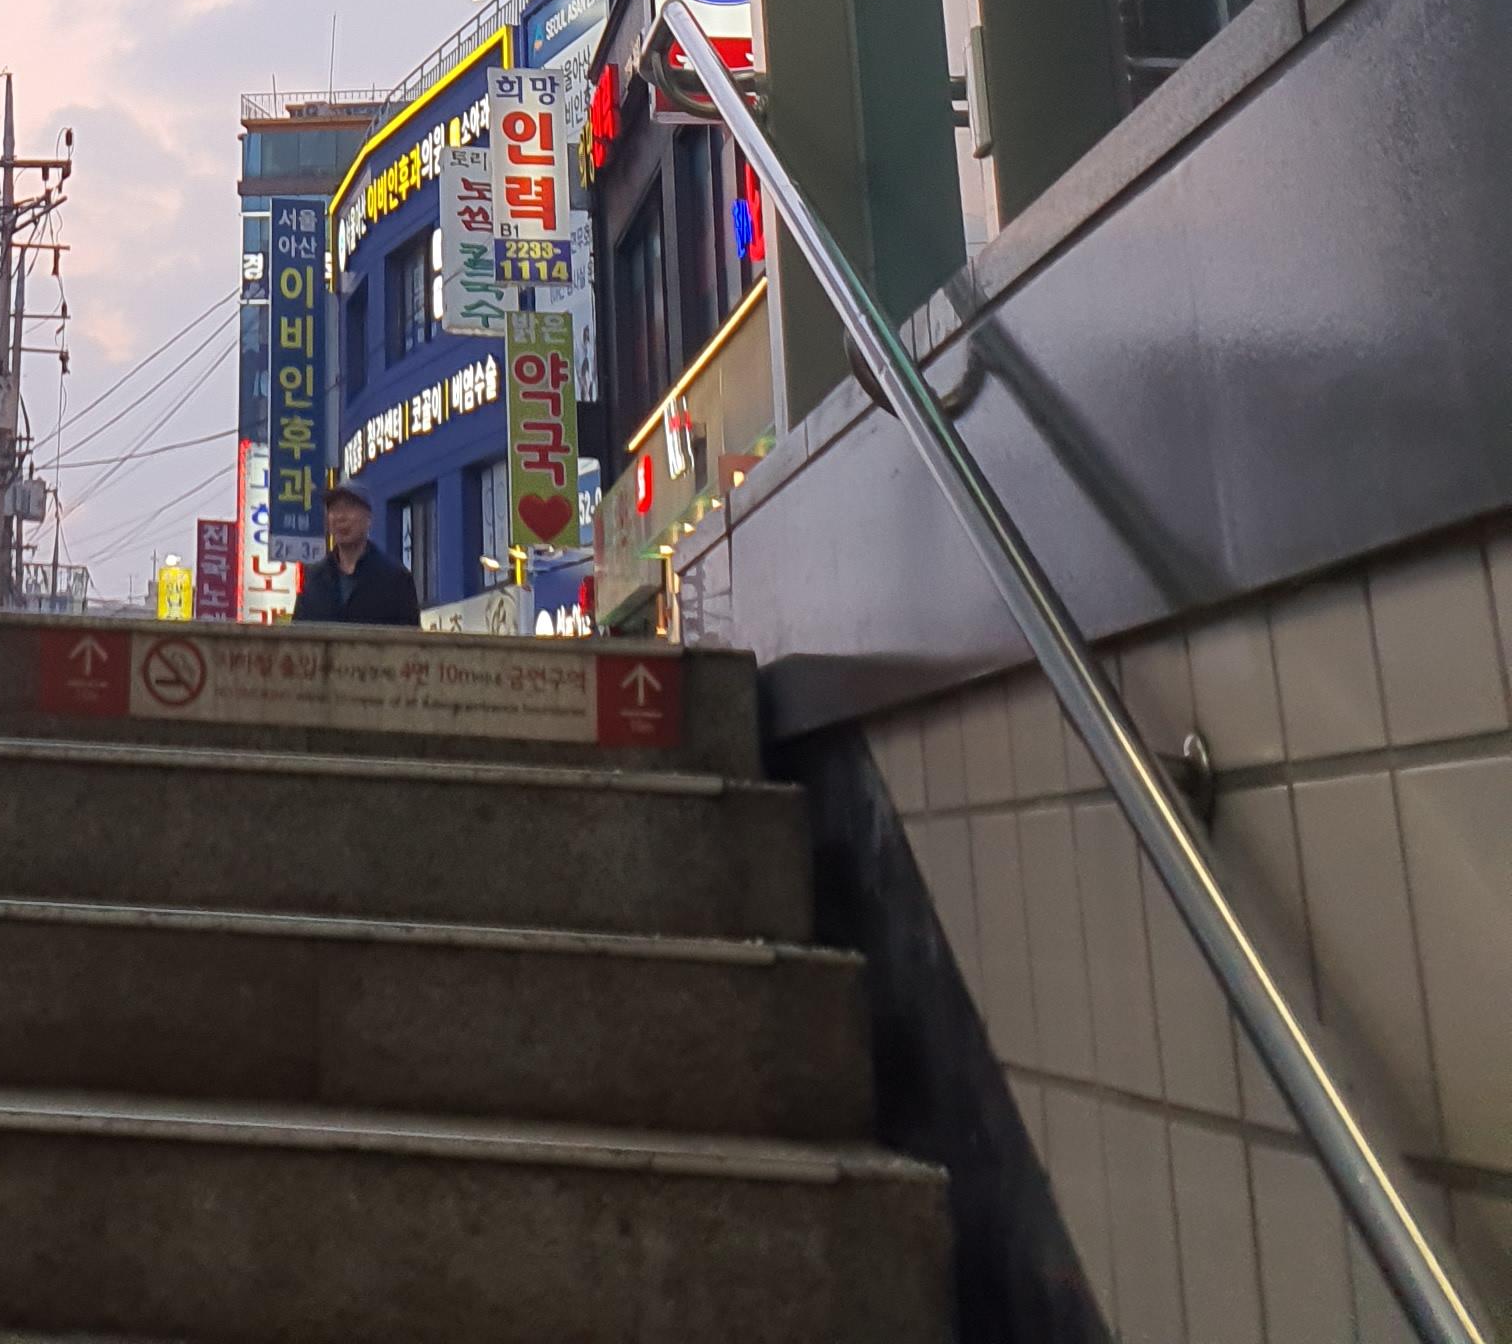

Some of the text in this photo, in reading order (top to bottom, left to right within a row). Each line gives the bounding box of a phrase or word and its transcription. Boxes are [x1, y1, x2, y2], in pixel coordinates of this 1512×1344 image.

[545, 11, 568, 40] SEOUL
[496, 76, 559, 105] 희망
[502, 111, 557, 231] 인력
[278, 208, 318, 233] 서울
[500, 223, 519, 238] B1
[278, 235, 318, 259] 아산
[506, 241, 561, 258] 2233-
[500, 260, 569, 281] 1114
[512, 313, 565, 344] 밝은
[278, 265, 317, 512] 이비인후과
[367, 402, 403, 459] 청각센터
[412, 382, 442, 433] 코골이
[452, 354, 497, 414] 비염수술
[514, 352, 571, 487] 약국
[274, 542, 321, 560] 2F 3F
